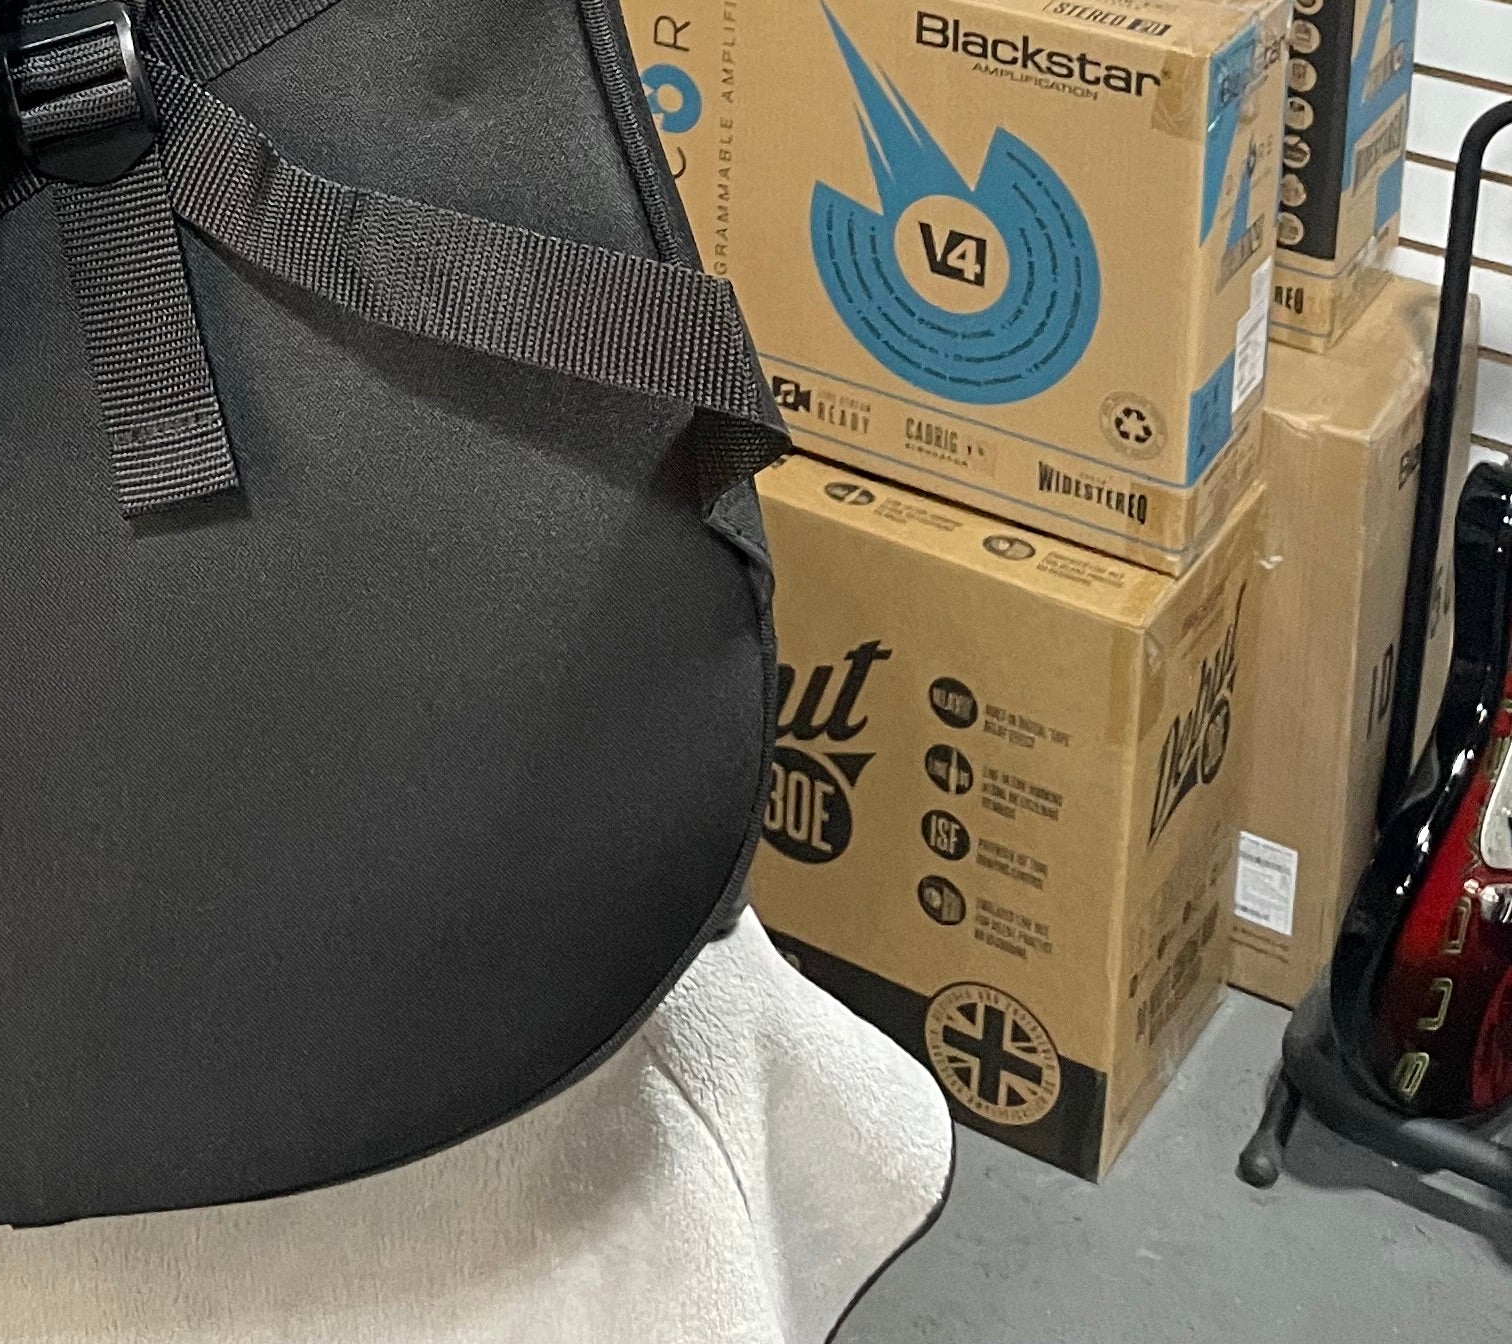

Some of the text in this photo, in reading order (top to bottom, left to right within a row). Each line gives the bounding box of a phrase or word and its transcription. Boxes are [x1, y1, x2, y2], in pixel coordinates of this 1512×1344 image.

[915, 9, 1162, 98] Blackstar
[971, 62, 1099, 102] AMPLIFICATION
[917, 221, 988, 289] V4
[1036, 459, 1150, 527] WIDESTEREO
[928, 814, 962, 856] ISF
